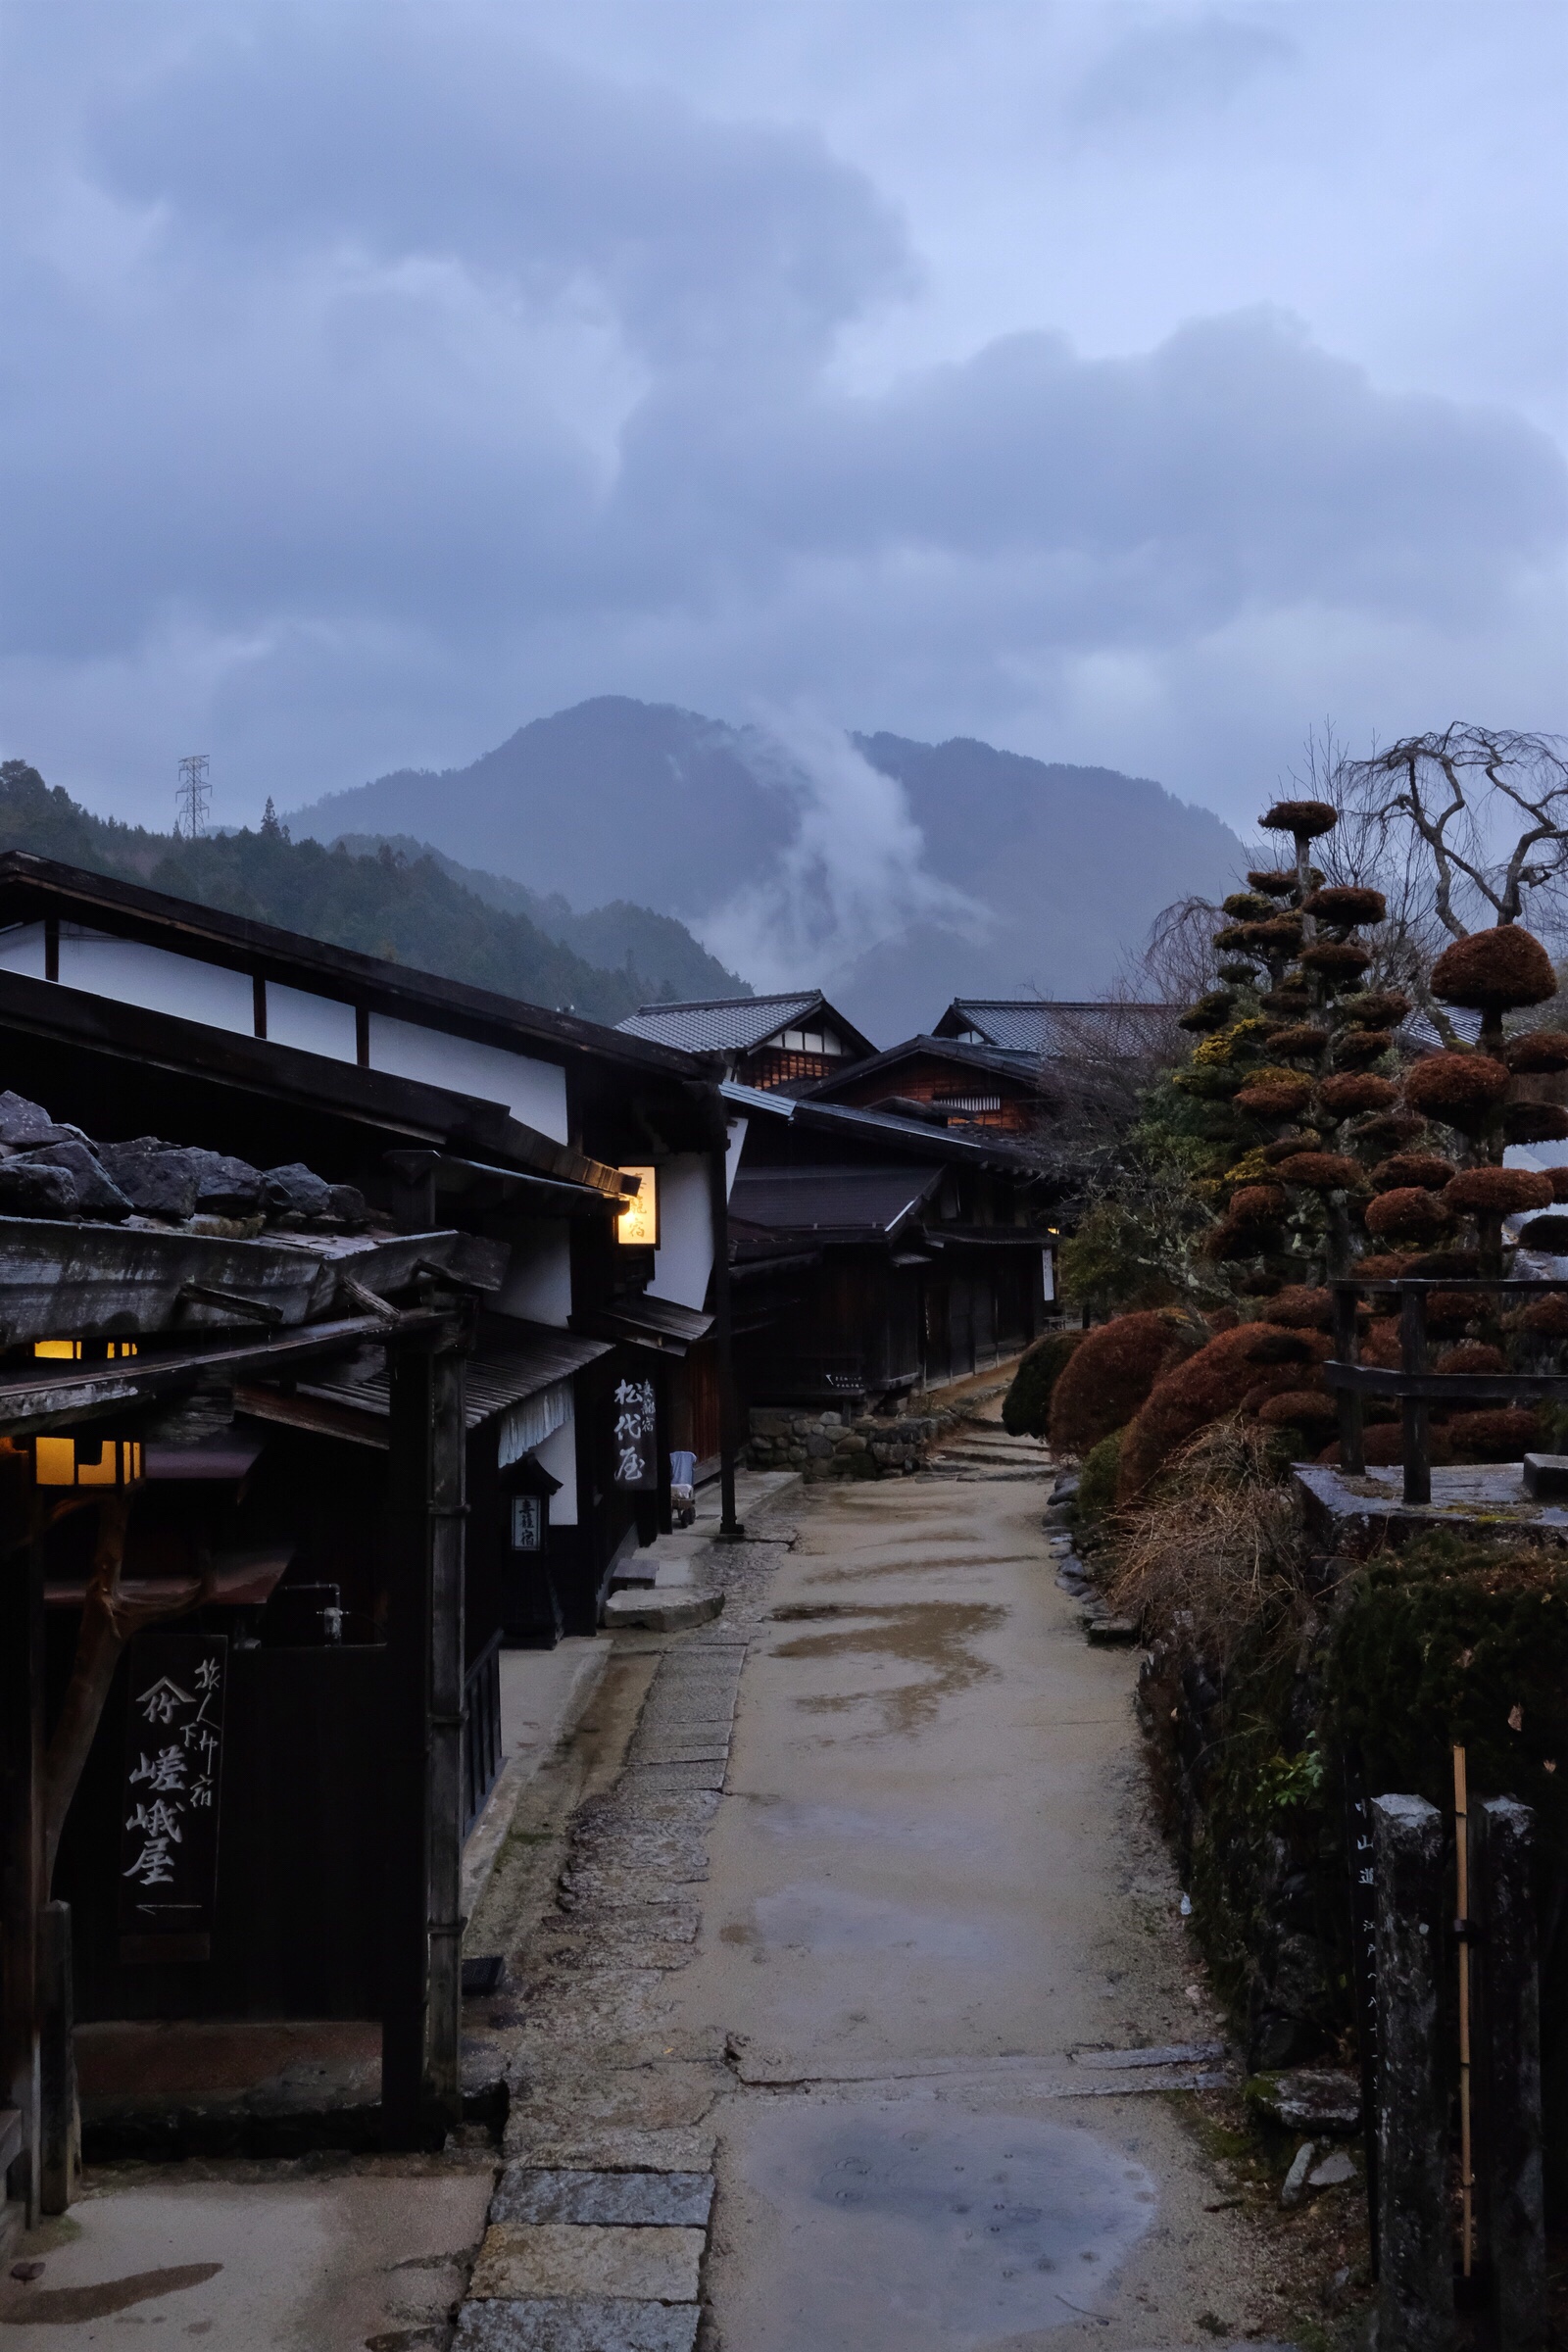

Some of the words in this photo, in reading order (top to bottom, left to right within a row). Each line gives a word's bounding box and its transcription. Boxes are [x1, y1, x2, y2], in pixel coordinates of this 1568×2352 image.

[613, 1378, 646, 1482] 松代屋
[640, 1378, 656, 1433] 妻籠宿
[518, 1498, 535, 1546] 妻籠宿
